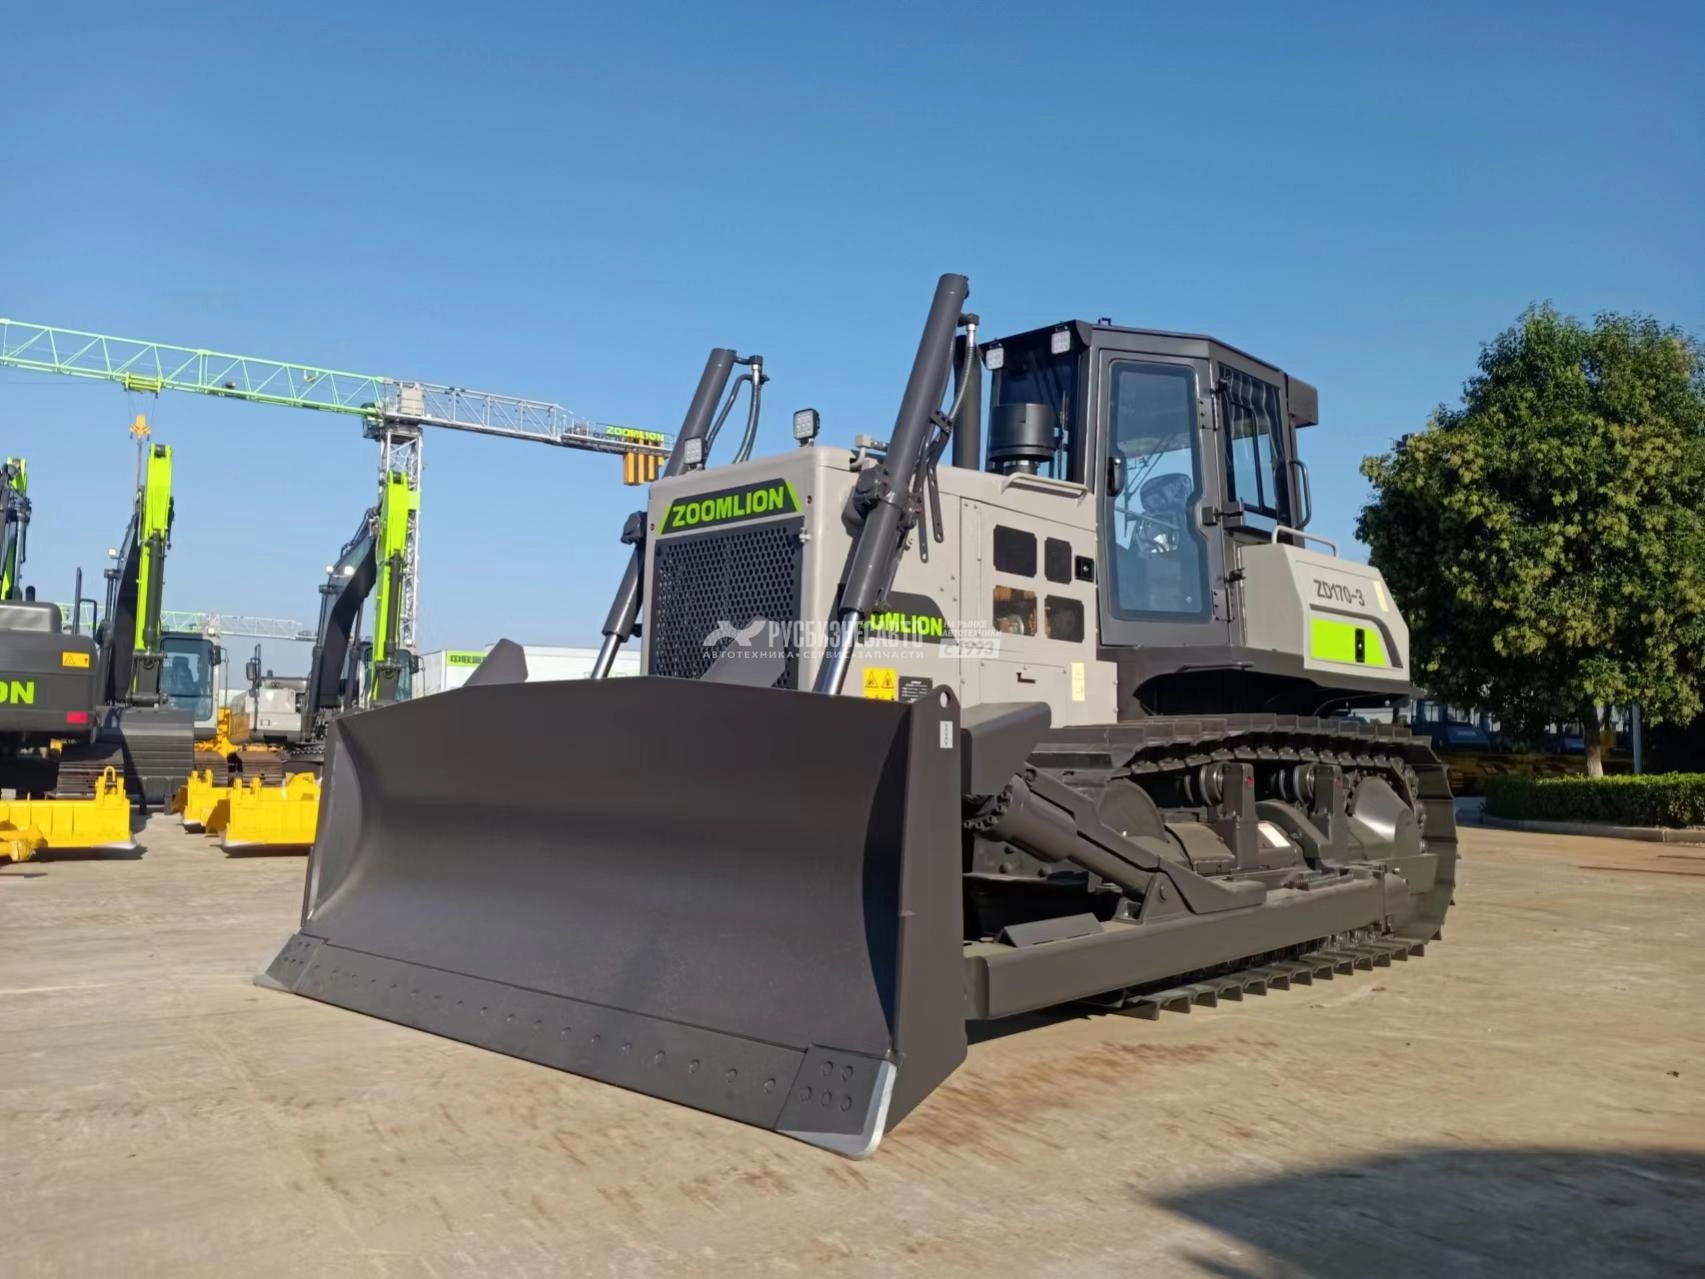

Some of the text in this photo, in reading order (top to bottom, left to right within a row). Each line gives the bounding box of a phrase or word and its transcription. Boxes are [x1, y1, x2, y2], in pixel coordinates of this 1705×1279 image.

[606, 425, 664, 441] ZOOMLION
[672, 486, 784, 527] ZOOMLION
[1313, 579, 1365, 607] ZD170-3
[870, 611, 942, 637] OMLION
